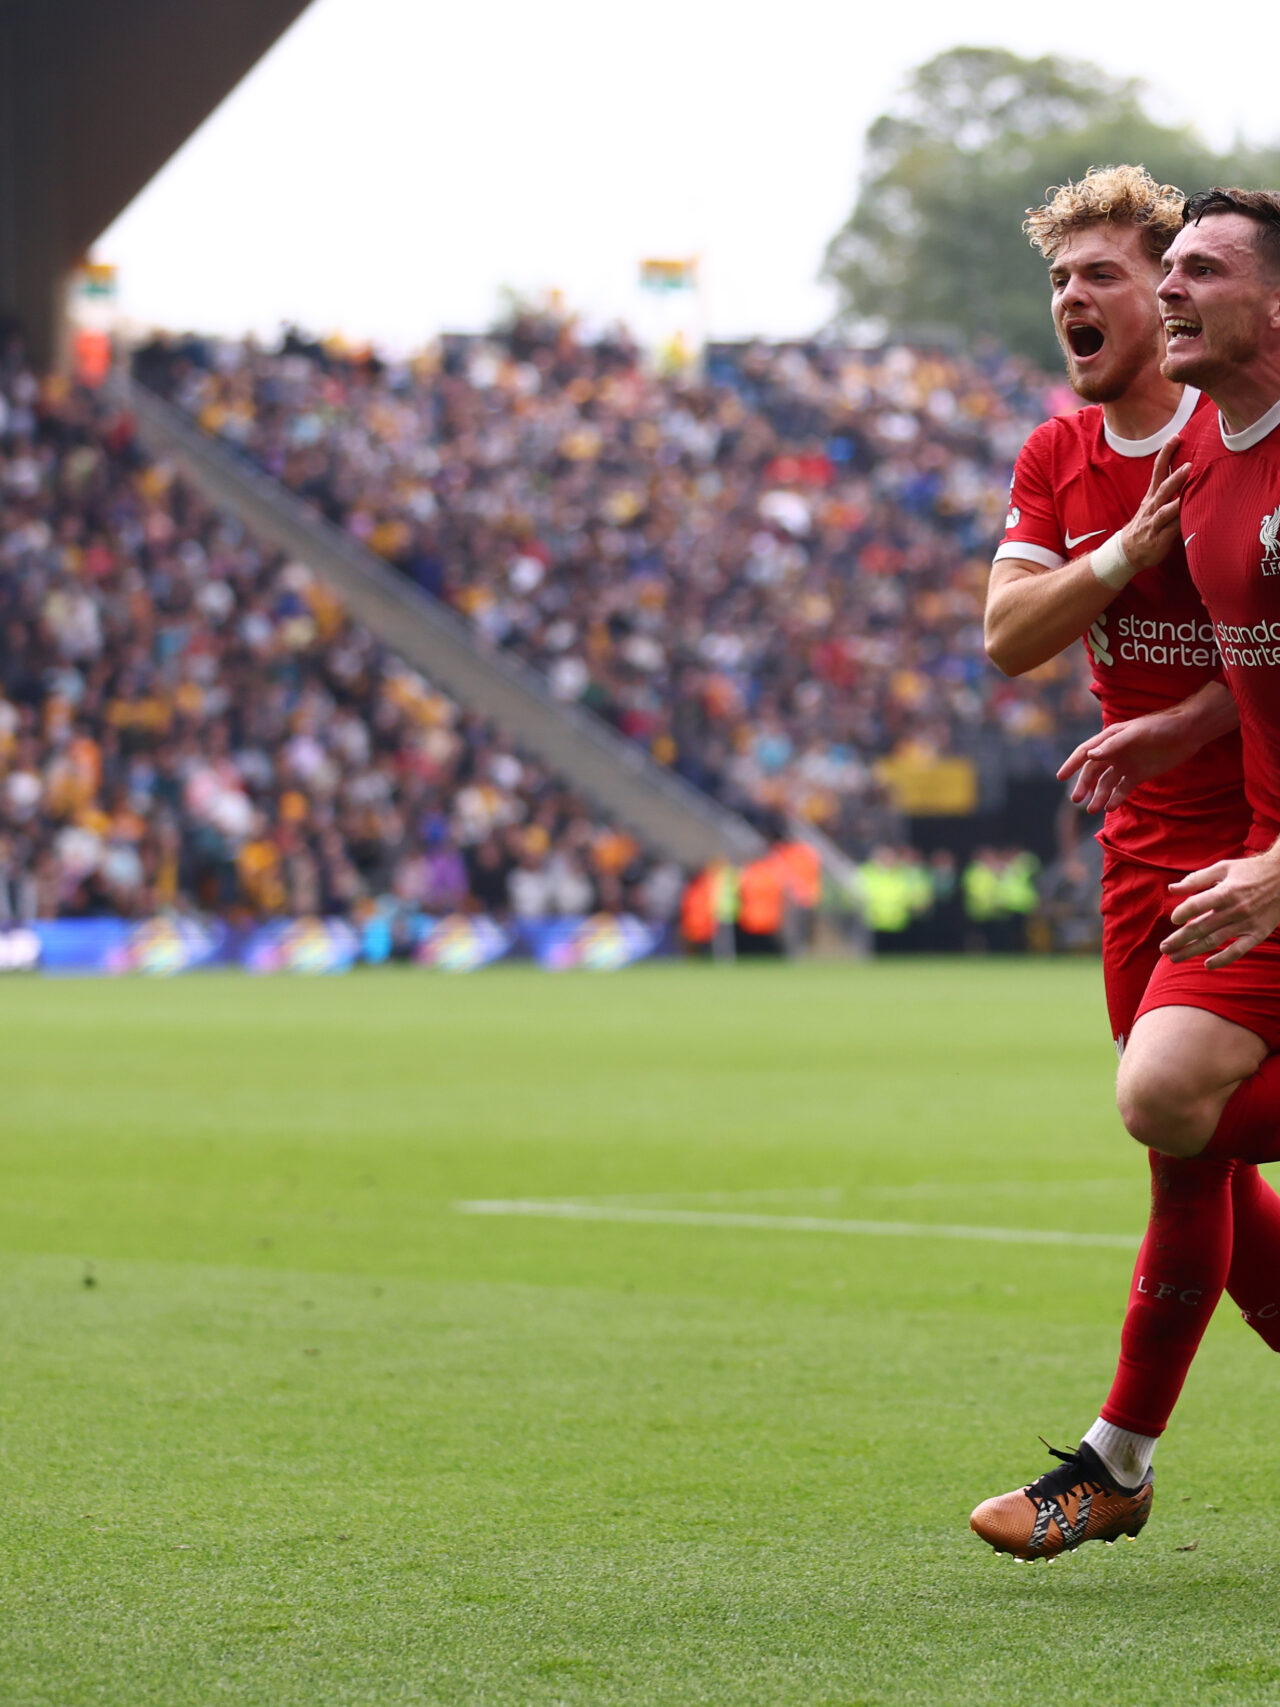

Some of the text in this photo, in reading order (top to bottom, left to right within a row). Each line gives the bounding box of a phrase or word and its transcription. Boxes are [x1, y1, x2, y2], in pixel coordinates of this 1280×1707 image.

[1118, 614, 1216, 642] standa
[1120, 639, 1220, 667] charter
[1136, 1275, 1203, 1305] LFC
